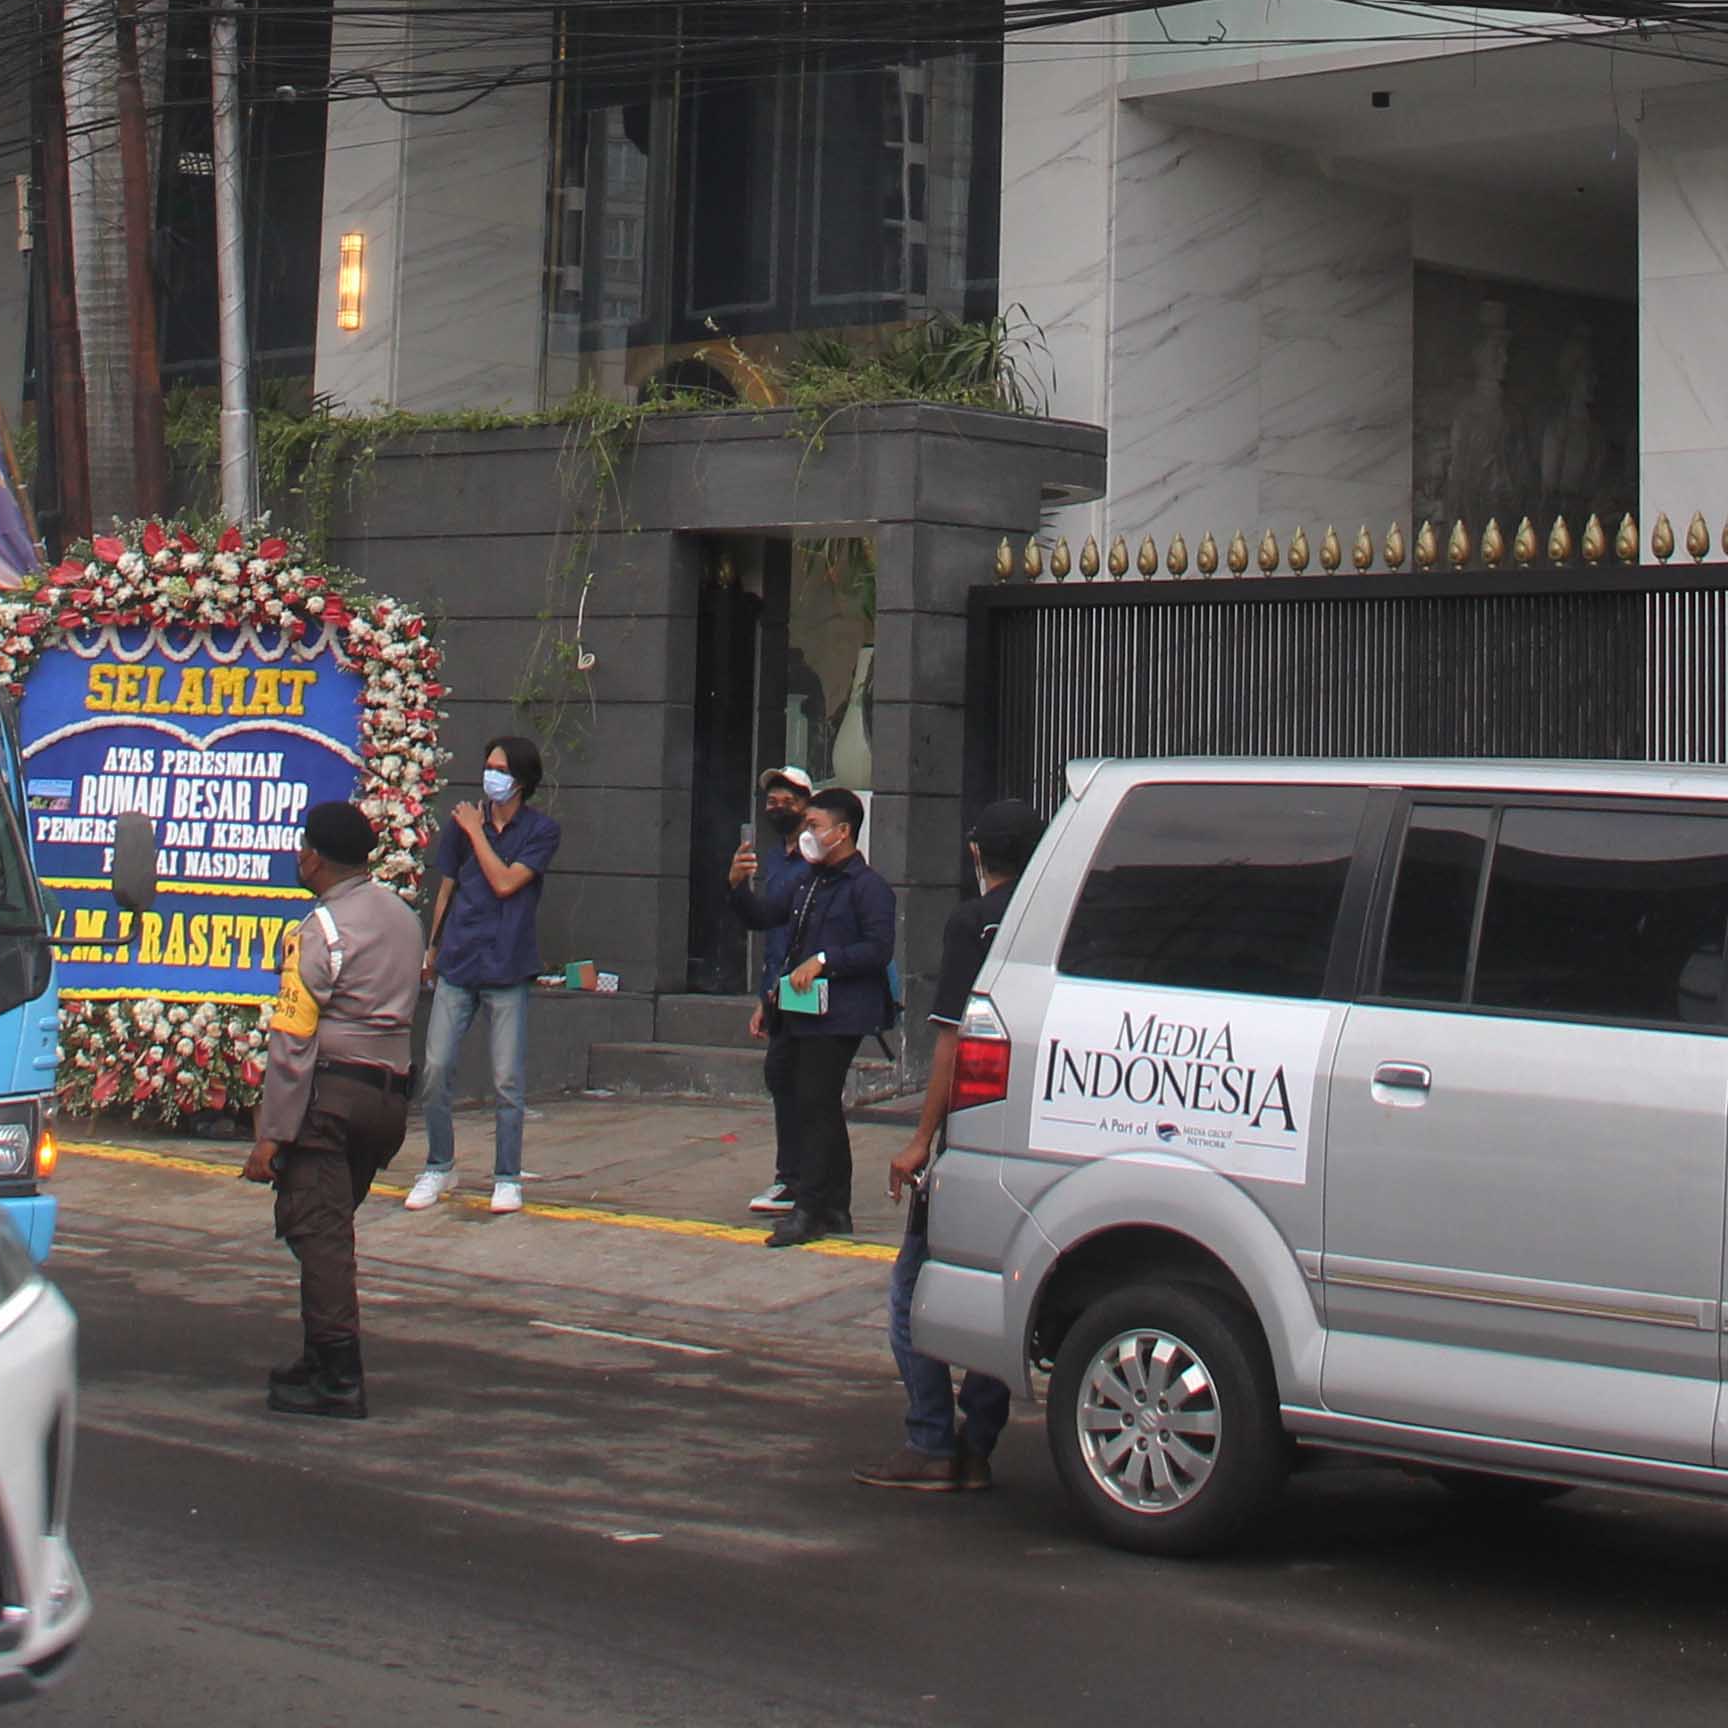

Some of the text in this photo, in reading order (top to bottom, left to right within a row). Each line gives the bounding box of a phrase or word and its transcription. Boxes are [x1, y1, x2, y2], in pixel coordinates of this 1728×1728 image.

[85, 663, 317, 715] SELAMAT
[103, 746, 284, 778] ATAS PERESMIAN
[80, 774, 167, 817] RUMAH
[172, 779, 252, 821] BESAR
[258, 781, 309, 823] DPP
[164, 821, 208, 847] DAN
[183, 851, 271, 880] NASDEM
[1113, 1011, 1236, 1063] MEDIA
[1043, 1038, 1298, 1133] INDONESIA
[1099, 1117, 1149, 1135] A Part of
[1186, 1136, 1226, 1149] NETWORK
